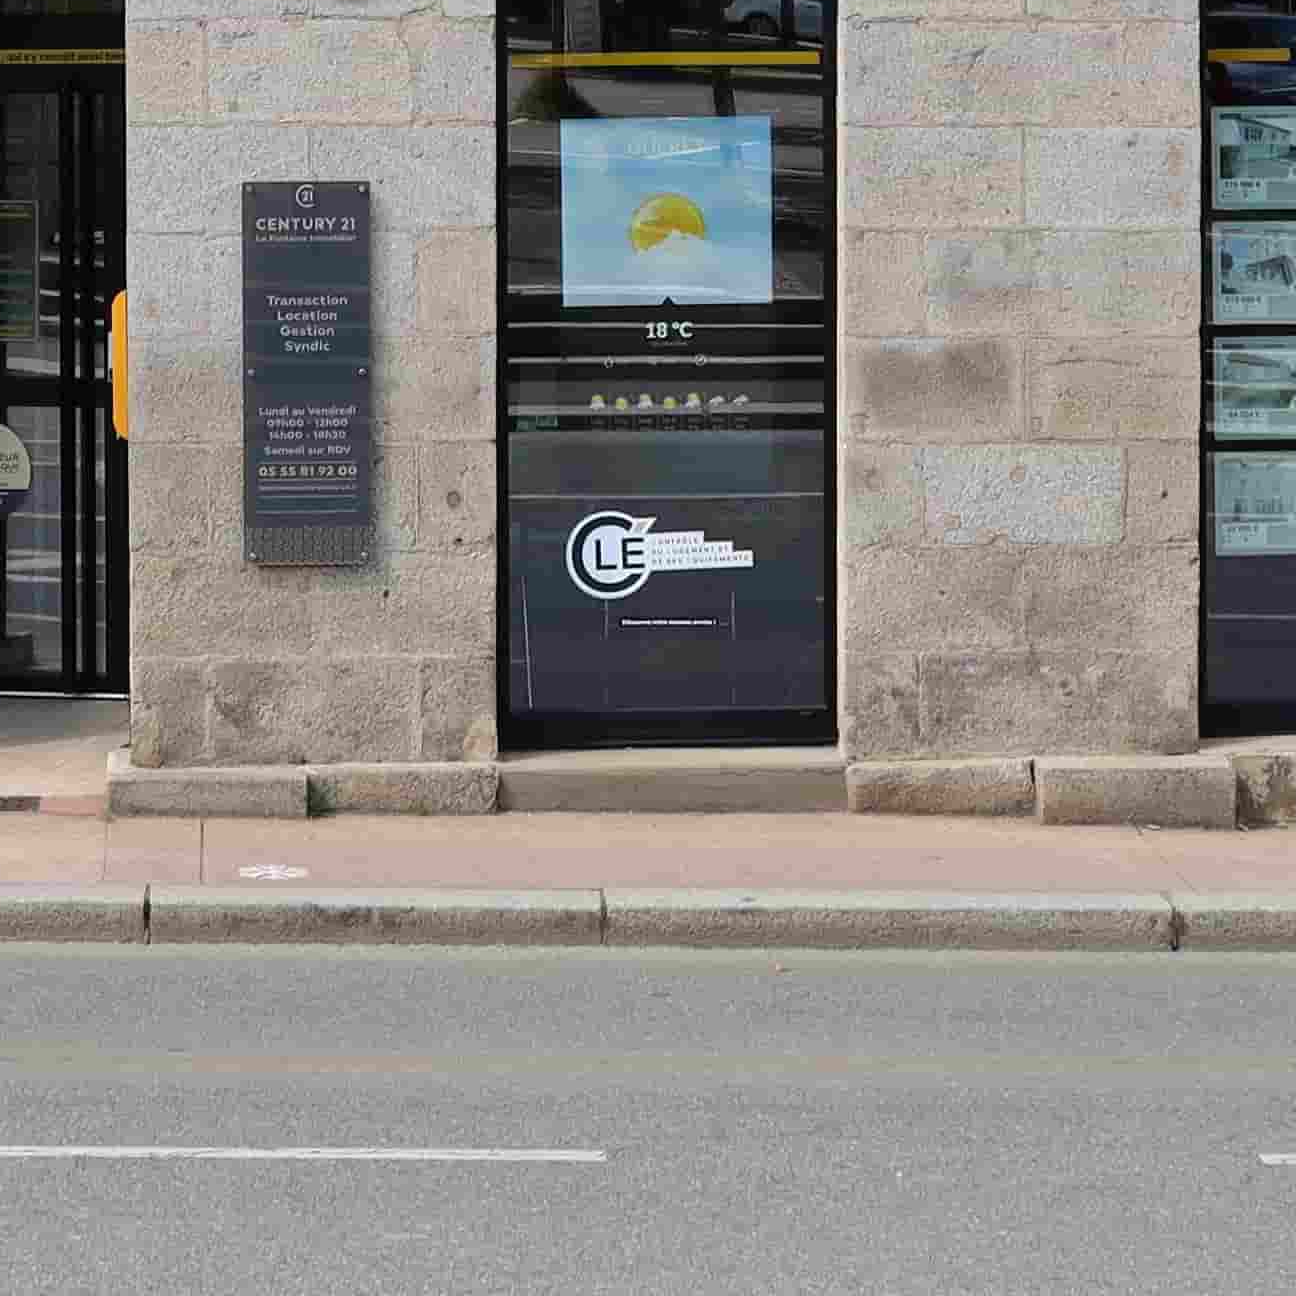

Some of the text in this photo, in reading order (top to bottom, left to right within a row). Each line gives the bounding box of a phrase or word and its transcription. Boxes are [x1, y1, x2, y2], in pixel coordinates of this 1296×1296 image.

[255, 217, 357, 232] CENTURY 21
[266, 295, 349, 306] Transaction
[277, 310, 338, 322] Location
[280, 324, 336, 337] Gestion
[645, 321, 694, 339] 18 °C
[284, 339, 331, 354] Syndic
[258, 406, 289, 417] Lundi
[258, 465, 277, 477] 05
[280, 465, 297, 477] 55
[318, 465, 335, 477] 92
[338, 465, 358, 477] 00
